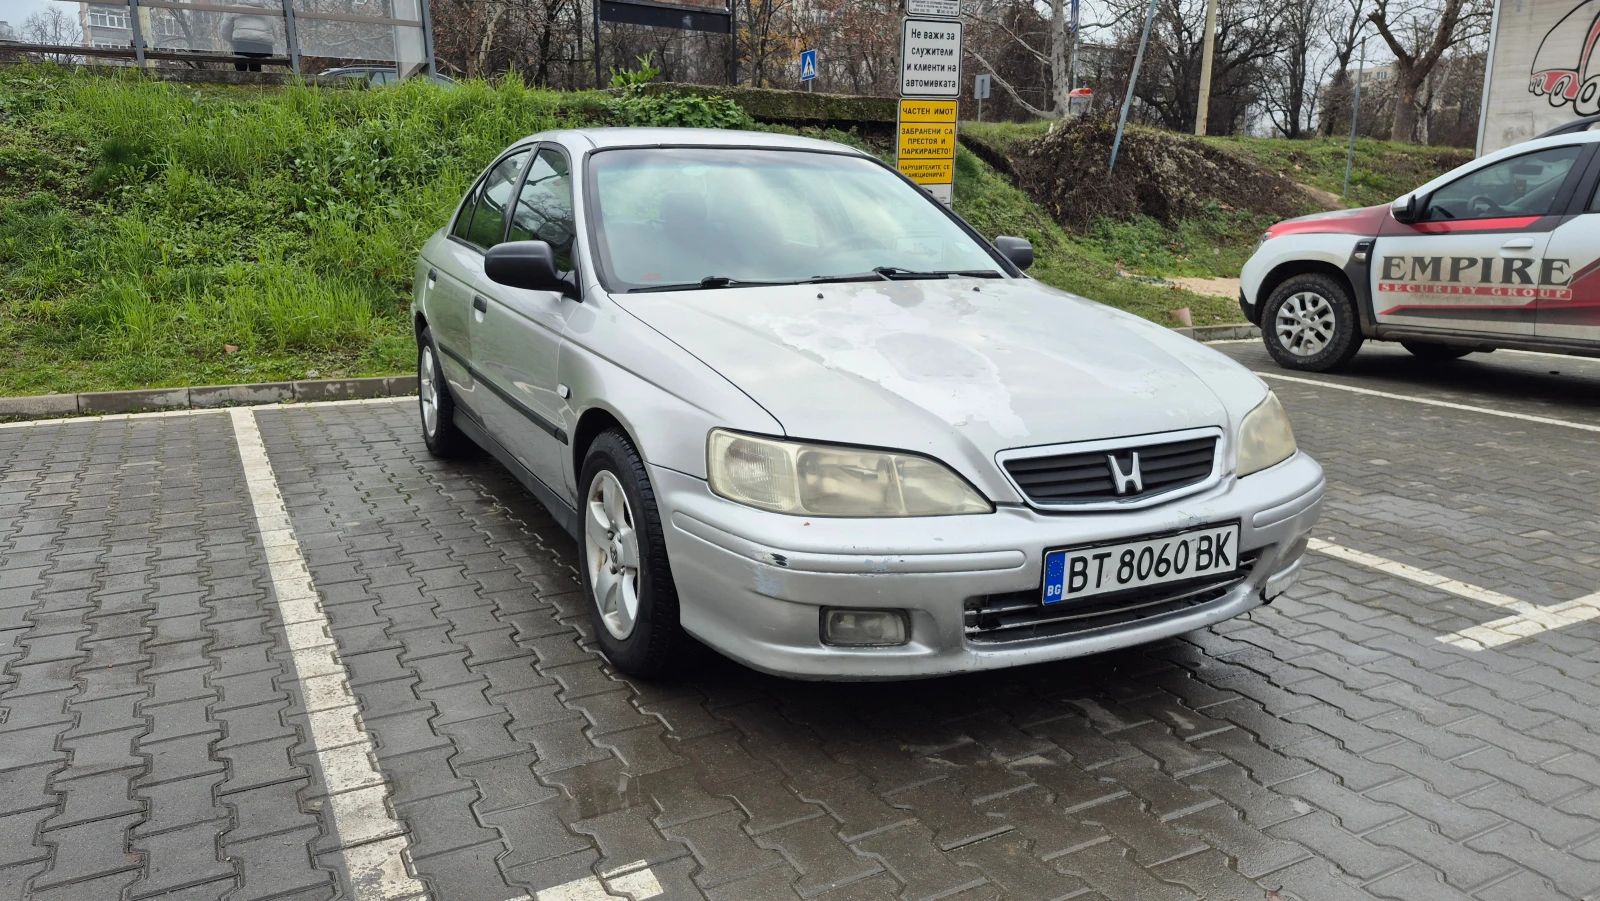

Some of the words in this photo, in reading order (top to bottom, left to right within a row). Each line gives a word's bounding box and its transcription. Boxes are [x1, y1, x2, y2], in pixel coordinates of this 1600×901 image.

[911, 28, 921, 39] Не
[923, 31, 944, 40] важи
[946, 32, 955, 40] за
[912, 47, 953, 57] служители
[906, 63, 911, 71] и
[913, 63, 945, 72] клиенти
[947, 64, 957, 72] на
[906, 80, 956, 88] автомивката
[1380, 256, 1571, 286] EMPIRE
[1382, 284, 1479, 294] SECURITY
[1491, 288, 1567, 298] GROUP
[1067, 552, 1112, 593] BT
[1116, 540, 1190, 584] 8060
[1195, 531, 1232, 571] BK
[1047, 585, 1062, 595] BG
